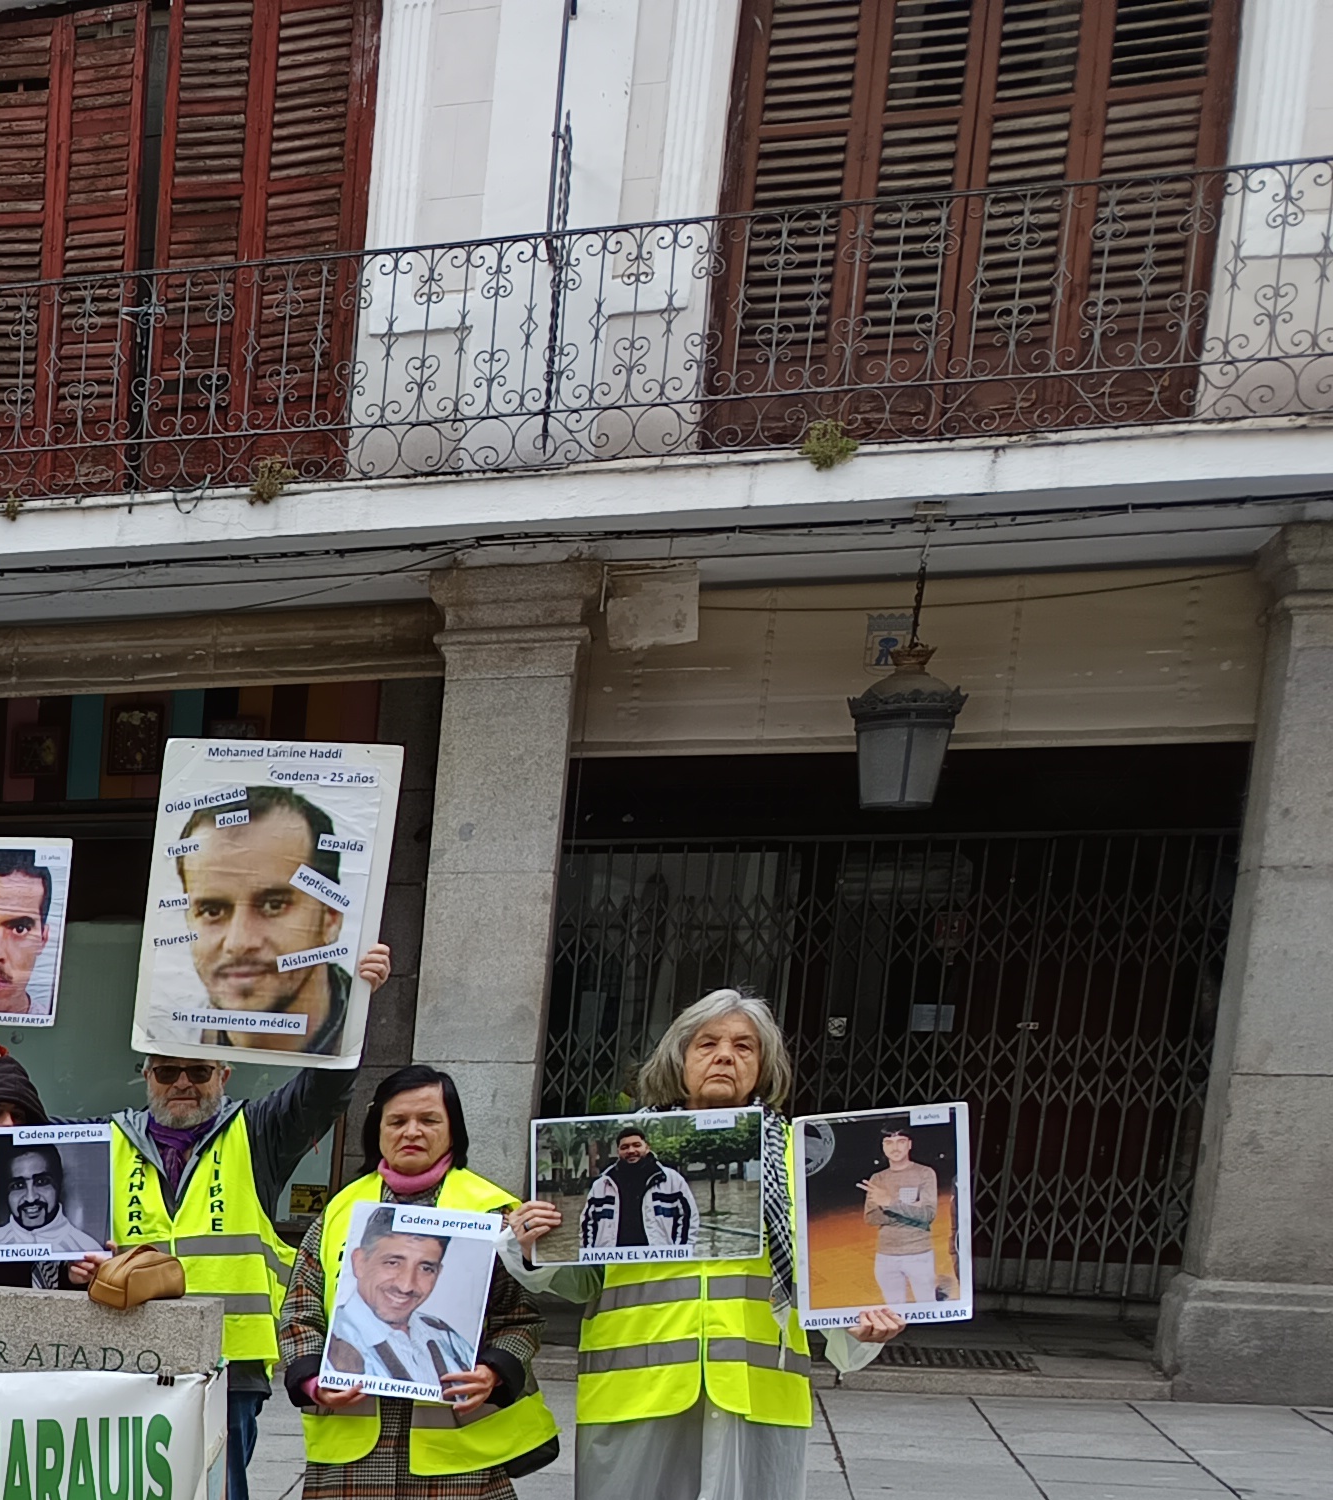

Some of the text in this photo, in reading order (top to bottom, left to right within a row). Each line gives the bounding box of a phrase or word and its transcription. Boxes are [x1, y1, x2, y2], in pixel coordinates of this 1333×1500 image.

[207, 747, 343, 760] Mohamed Lamine Haddi
[269, 769, 375, 784] Condena 25 años
[166, 789, 246, 813] Oído infectado
[218, 813, 248, 826] dolor
[168, 842, 199, 857] fiebre
[321, 838, 364, 851] espalda
[298, 872, 350, 907] septicemia
[158, 897, 188, 909] Asma
[154, 932, 198, 947] Enuresis
[282, 947, 348, 968] Aislamiento
[171, 1011, 301, 1029] Sin tratamiento médico
[712, 1118, 729, 1126] años
[18, 1128, 103, 1141] Cadena perpetua
[127, 1153, 145, 1236] SAHARA
[211, 1151, 223, 1231] LIBRE
[400, 1214, 491, 1231] Cadena perpetua
[581, 1247, 690, 1263] AIMAN EL YATRIBI
[804, 1317, 841, 1328] ABIDIN
[904, 1311, 936, 1321] FADEL
[940, 1309, 967, 1319] LBAR
[379, 1383, 439, 1398] LEKHFAUNI
